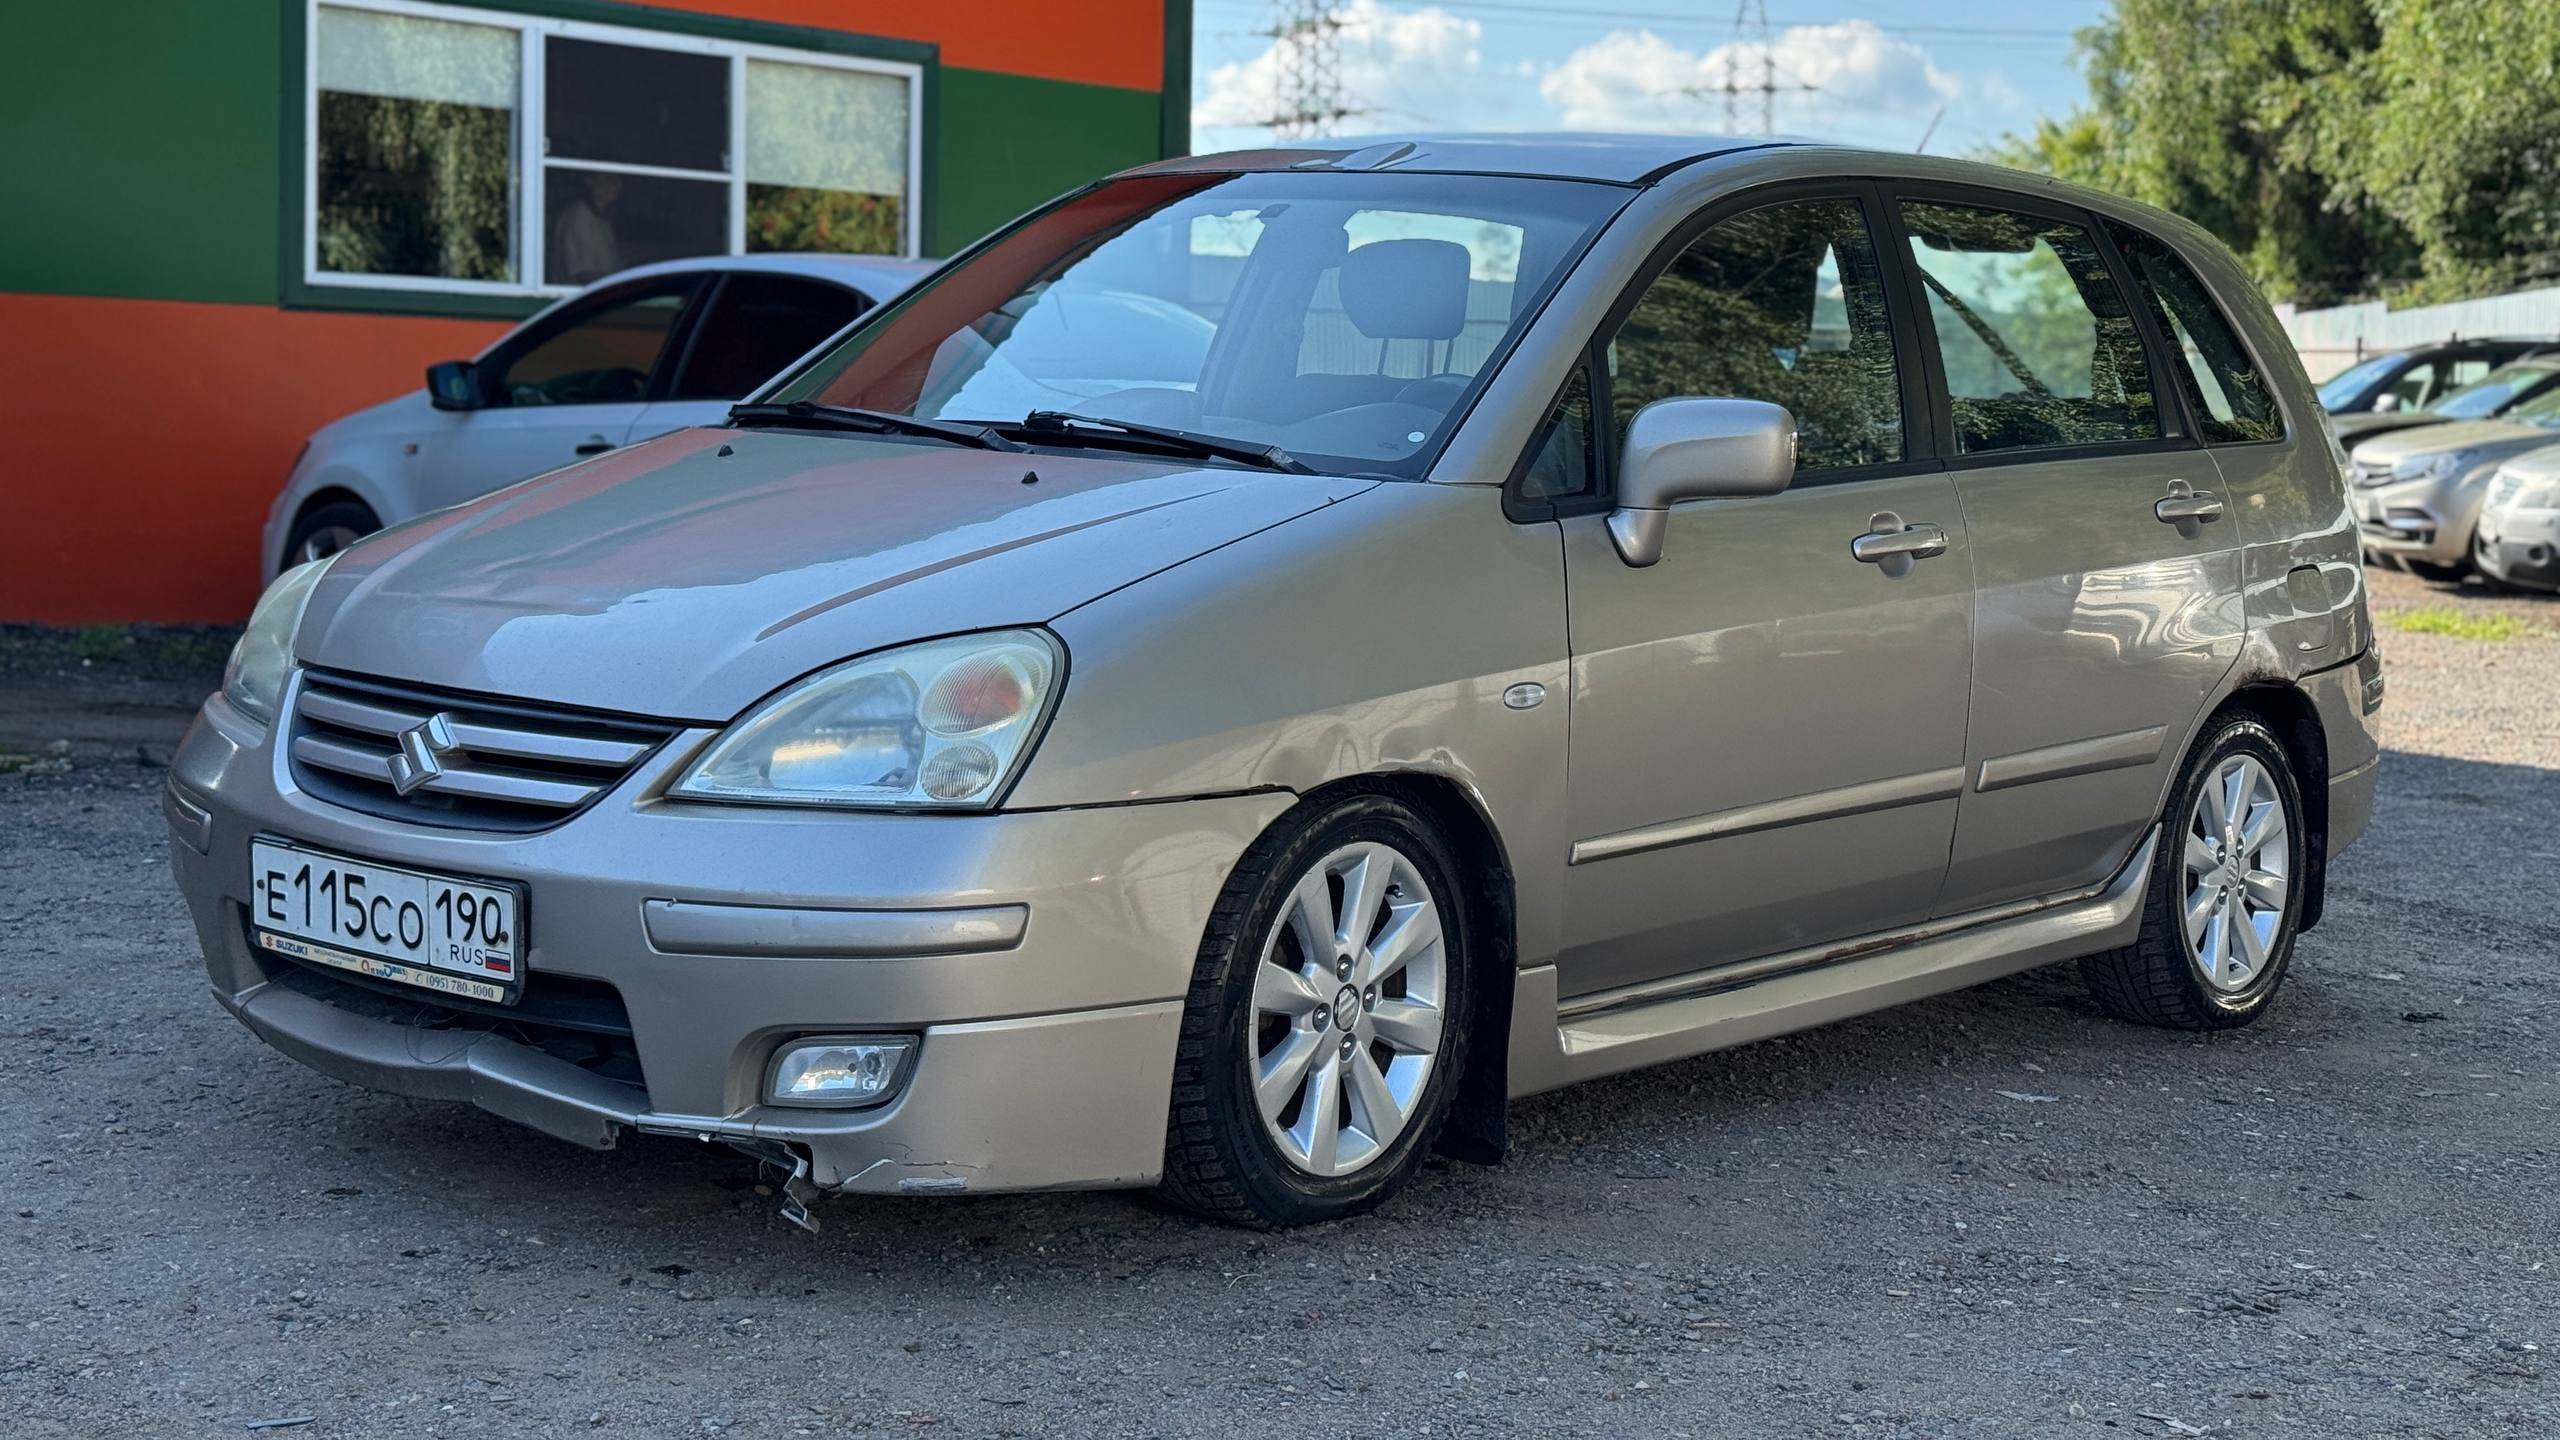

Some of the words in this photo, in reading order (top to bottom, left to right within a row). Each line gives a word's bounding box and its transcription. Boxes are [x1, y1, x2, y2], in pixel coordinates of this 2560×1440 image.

[435, 888, 502, 945] 190
[275, 939, 308, 955] SUZUKI
[450, 944, 483, 966] RUS
[426, 975, 449, 989] (095)
[450, 980, 494, 998] 780-1000
